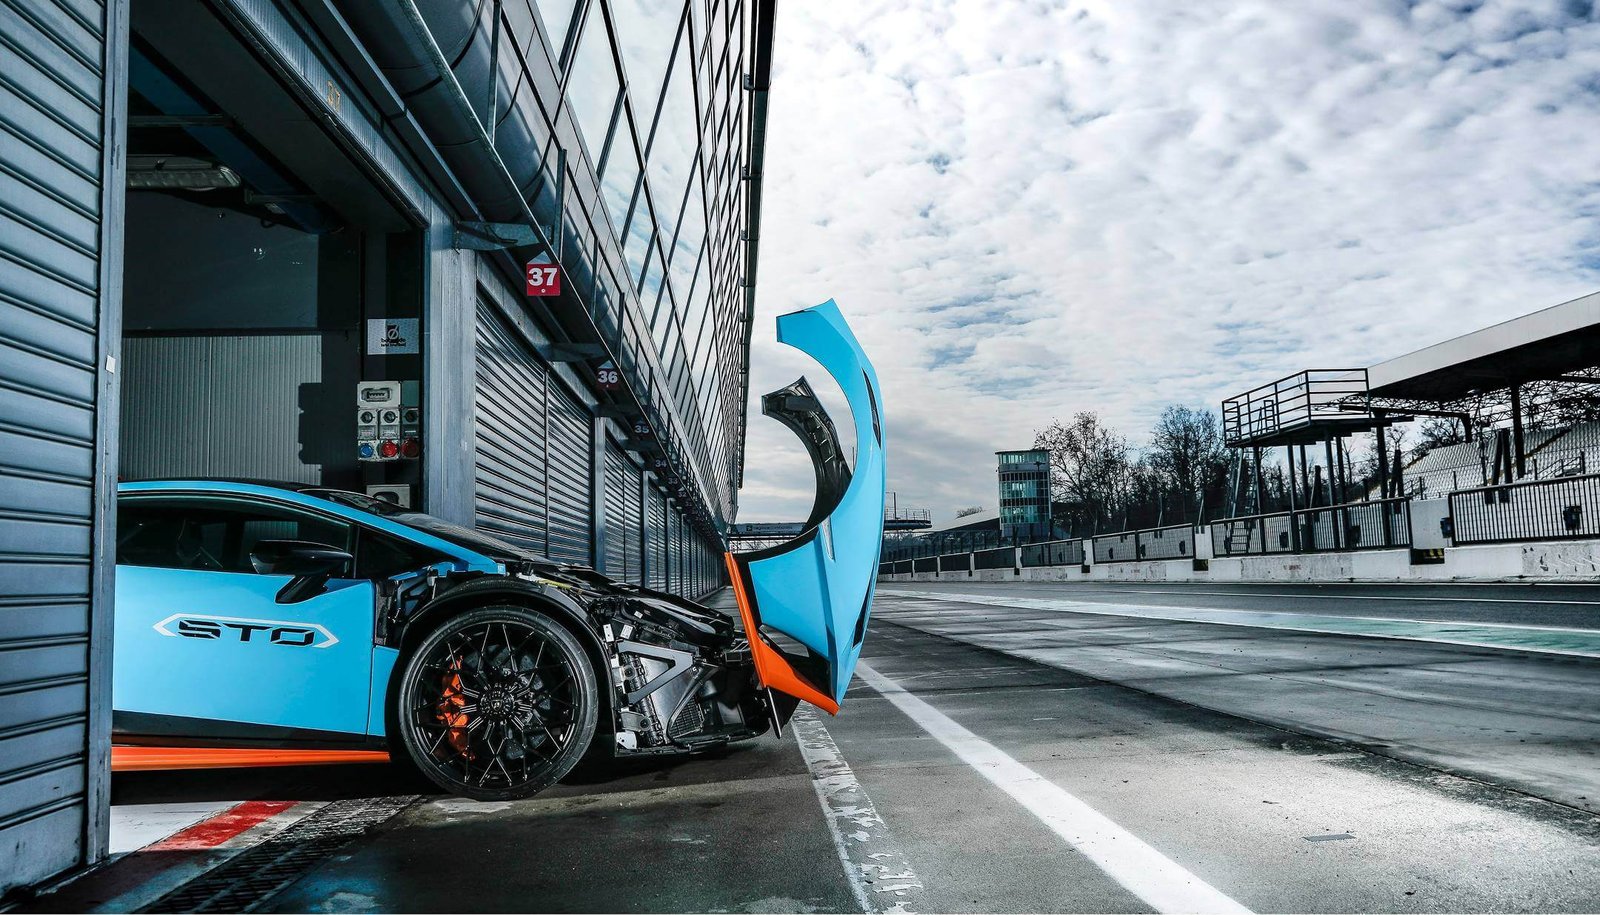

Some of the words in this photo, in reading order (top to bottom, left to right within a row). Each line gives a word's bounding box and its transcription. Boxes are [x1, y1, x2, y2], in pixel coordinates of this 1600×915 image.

[528, 267, 558, 286] 37
[597, 370, 618, 384] 36
[634, 425, 649, 433] 35
[177, 619, 316, 647] STO
